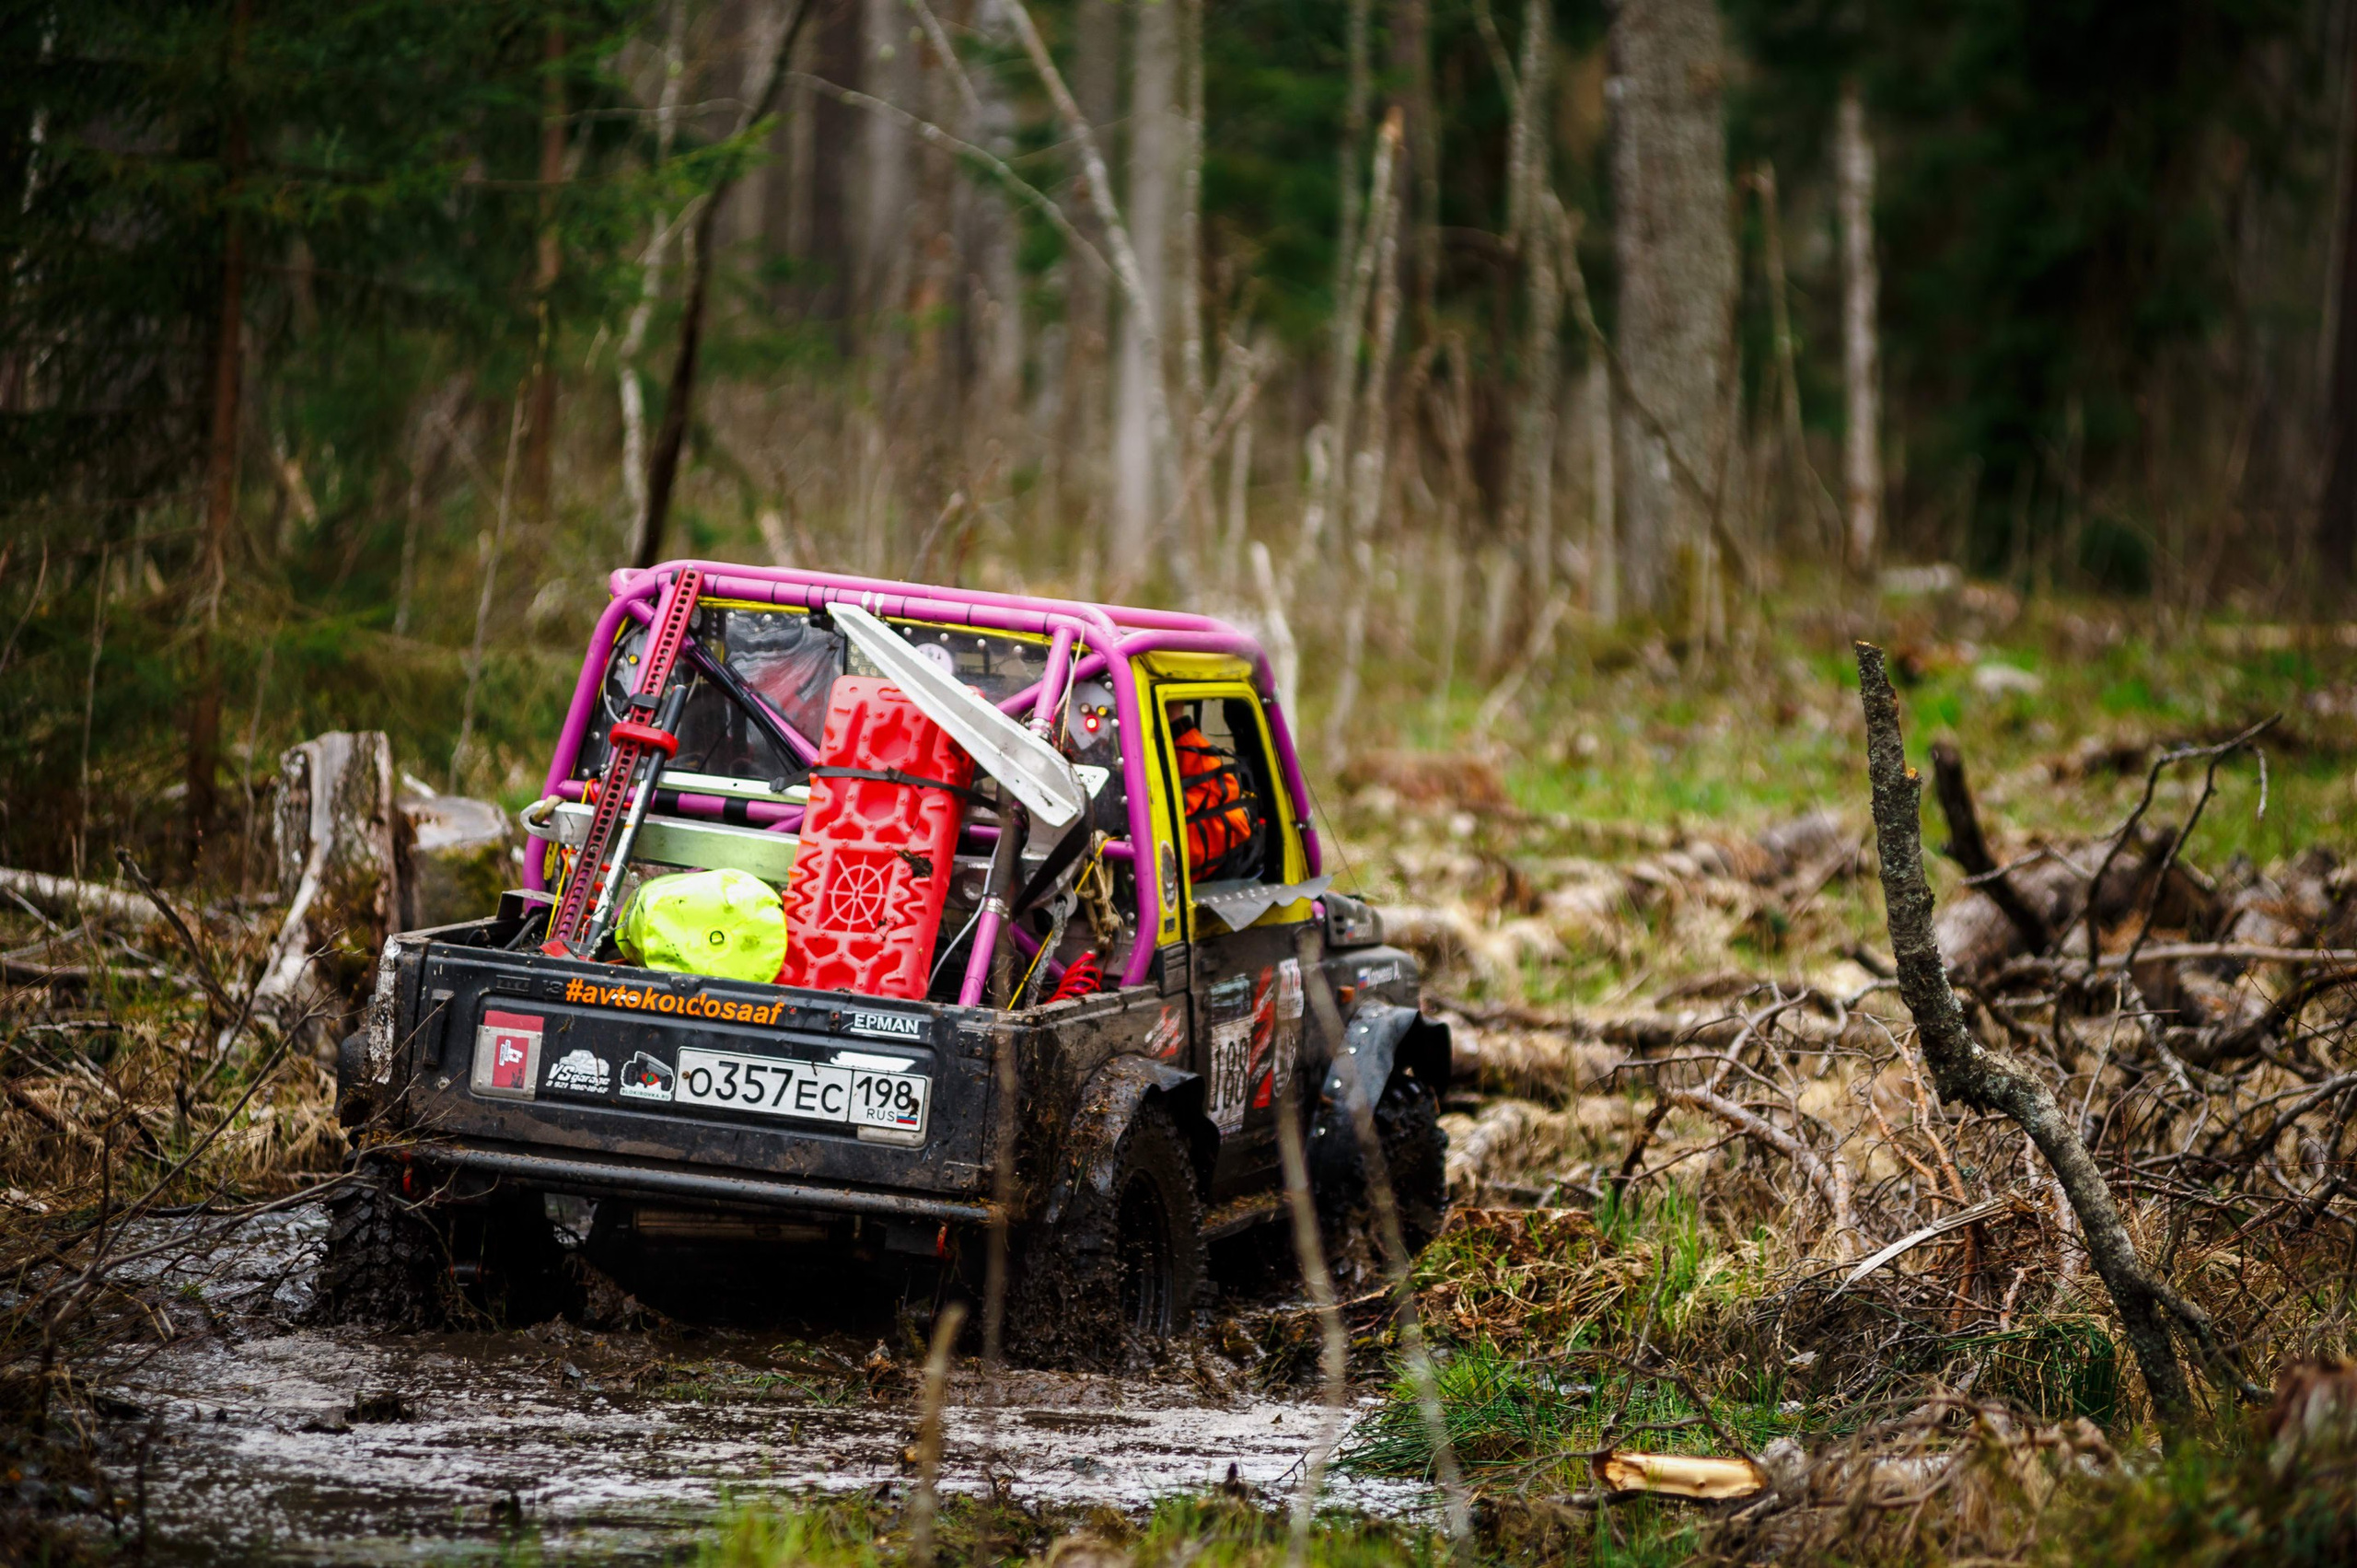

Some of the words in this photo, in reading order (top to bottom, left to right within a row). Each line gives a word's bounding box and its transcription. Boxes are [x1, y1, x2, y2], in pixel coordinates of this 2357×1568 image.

[549, 1063, 575, 1081] VS
[688, 1061, 843, 1114] O357EC
[856, 1075, 912, 1111] 198
[1208, 1038, 1248, 1112] 188
[866, 1108, 895, 1122] RUS
